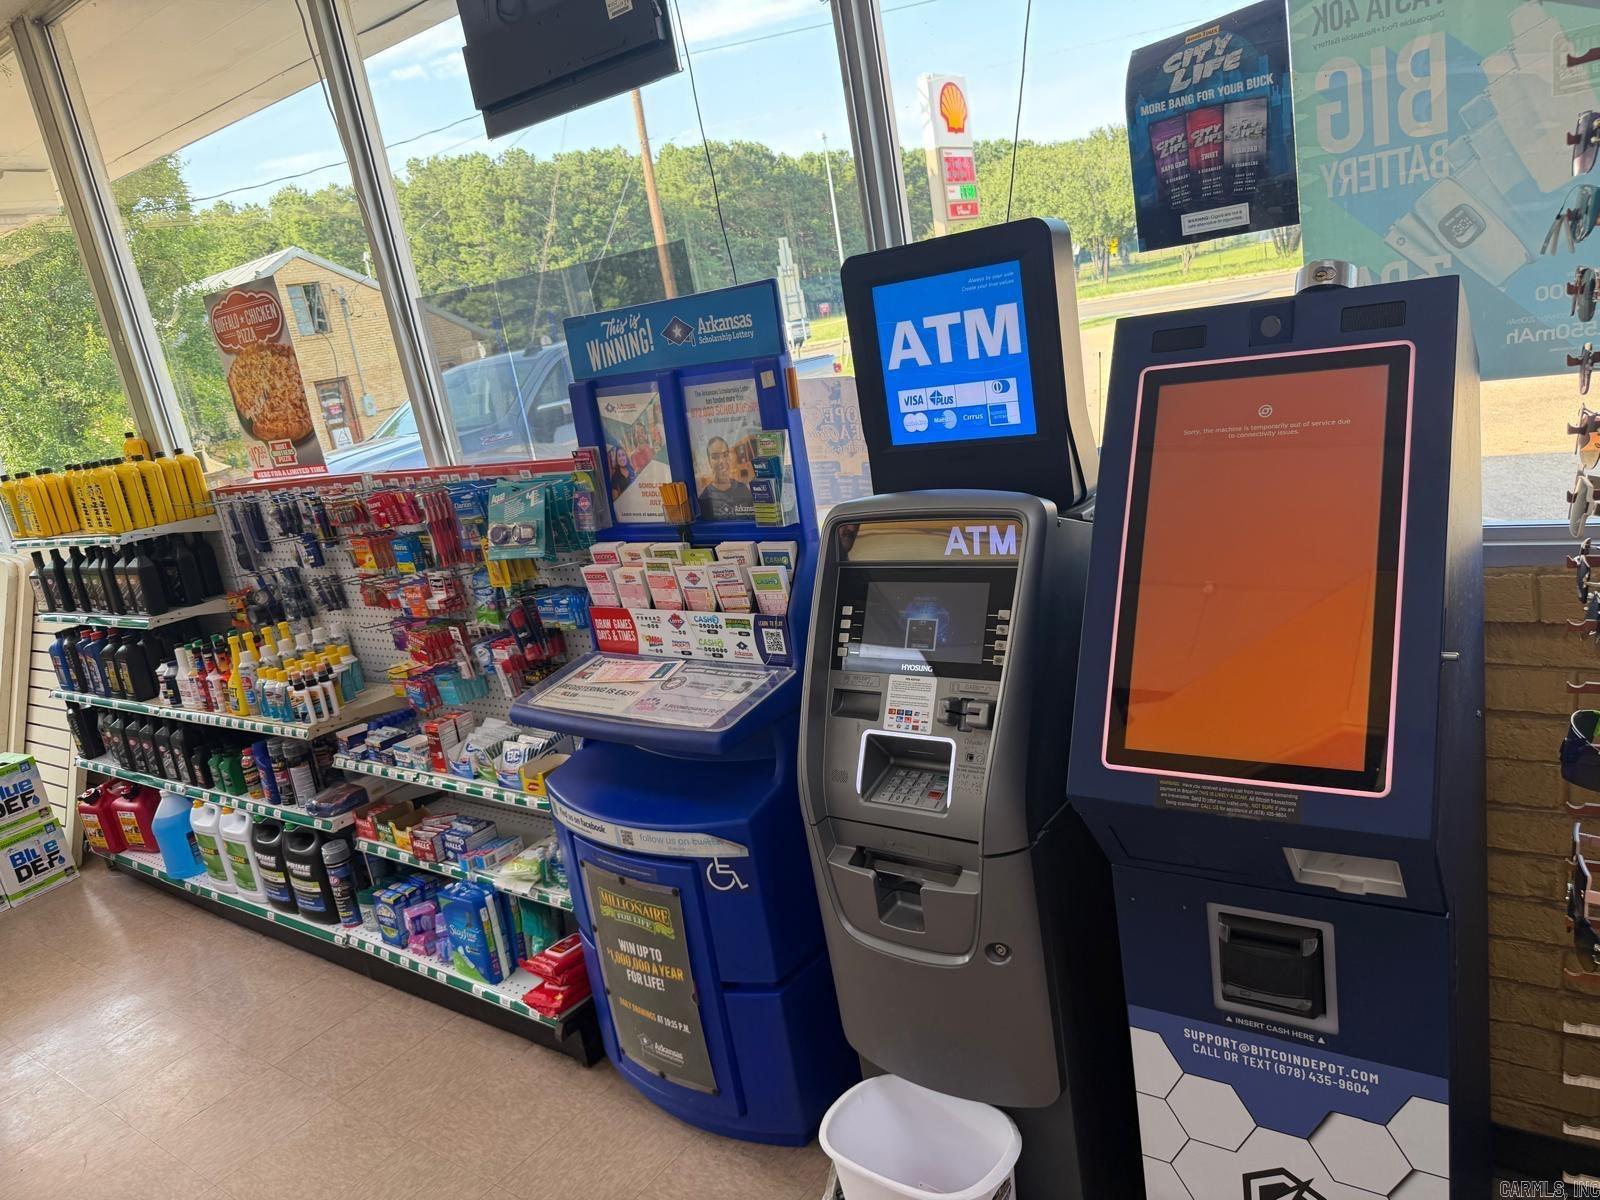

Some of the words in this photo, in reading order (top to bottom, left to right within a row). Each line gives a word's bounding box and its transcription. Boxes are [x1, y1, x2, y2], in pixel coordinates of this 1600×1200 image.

[1162, 32, 1233, 74] CITY
[1168, 48, 1243, 94] LIFE
[1140, 102, 1167, 117] MORE
[1168, 94, 1195, 109] BANG
[1196, 88, 1216, 102] FOR
[1216, 82, 1244, 97] YOUR
[1246, 73, 1274, 90] BUCK
[1191, 124, 1222, 140] CITY
[1194, 131, 1224, 148] LIFE
[1155, 133, 1185, 151] CITY
[1160, 141, 1188, 159] LIFE
[1200, 151, 1219, 160] SWEET
[214, 313, 240, 334] BUFFALO
[244, 303, 278, 326] CHICKEN
[600, 317, 628, 340] This
[629, 313, 641, 329] is
[698, 313, 753, 335] Arkansas
[236, 326, 258, 345] PIZZA
[698, 333, 732, 345] Scholarship
[732, 330, 754, 342] Lottery
[888, 302, 1022, 371] ATM
[585, 317, 656, 373] WINNING!
[903, 394, 924, 407] VISA
[936, 395, 954, 405] PLUS
[963, 413, 984, 421] Cirrus
[1184, 429, 1201, 437] Sorry,
[1250, 423, 1288, 432] temporarily
[1236, 430, 1276, 439] connectivity
[944, 525, 1017, 556] ATM
[594, 619, 611, 629] DRAW
[612, 619, 633, 630] GAMES
[596, 629, 612, 640] DAYS
[612, 630, 619, 640] &
[618, 630, 636, 642] TIMES
[901, 663, 933, 673] HYOSUNG
[561, 684, 607, 693] REGISTERING
[615, 689, 640, 697] EASY!
[0, 778, 33, 801] lue
[413, 840, 431, 850] HALLS
[445, 841, 462, 850] HALLS
[639, 834, 664, 844] follow
[665, 838, 675, 846] us
[679, 839, 690, 847] on
[255, 851, 277, 864] PRIME
[286, 860, 311, 872] PRIME
[14, 850, 60, 884] DEF
[600, 890, 668, 924] MILLIONAIRE
[616, 912, 632, 922] FOR
[633, 917, 651, 928] LIFE
[617, 938, 636, 956] WIN
[636, 943, 649, 958] UP
[649, 947, 662, 962] TO
[626, 969, 643, 985] FOR
[643, 974, 665, 991] LIFE!
[652, 962, 659, 977] A
[658, 964, 684, 982] YEAR
[656, 1014, 664, 1025] AT
[1235, 1017, 1265, 1030] INSERT
[1266, 1024, 1291, 1036] CASH
[1291, 1030, 1315, 1042] HERE
[1183, 1028, 1380, 1085] SUPPORT@BITCOINDEPOT.COM
[1192, 1043, 1221, 1059] CALL
[1223, 1051, 1239, 1064] OR
[1243, 1056, 1271, 1072] TEXT
[1274, 1063, 1306, 1081] (678)
[1308, 1072, 1370, 1096] 435-9604
